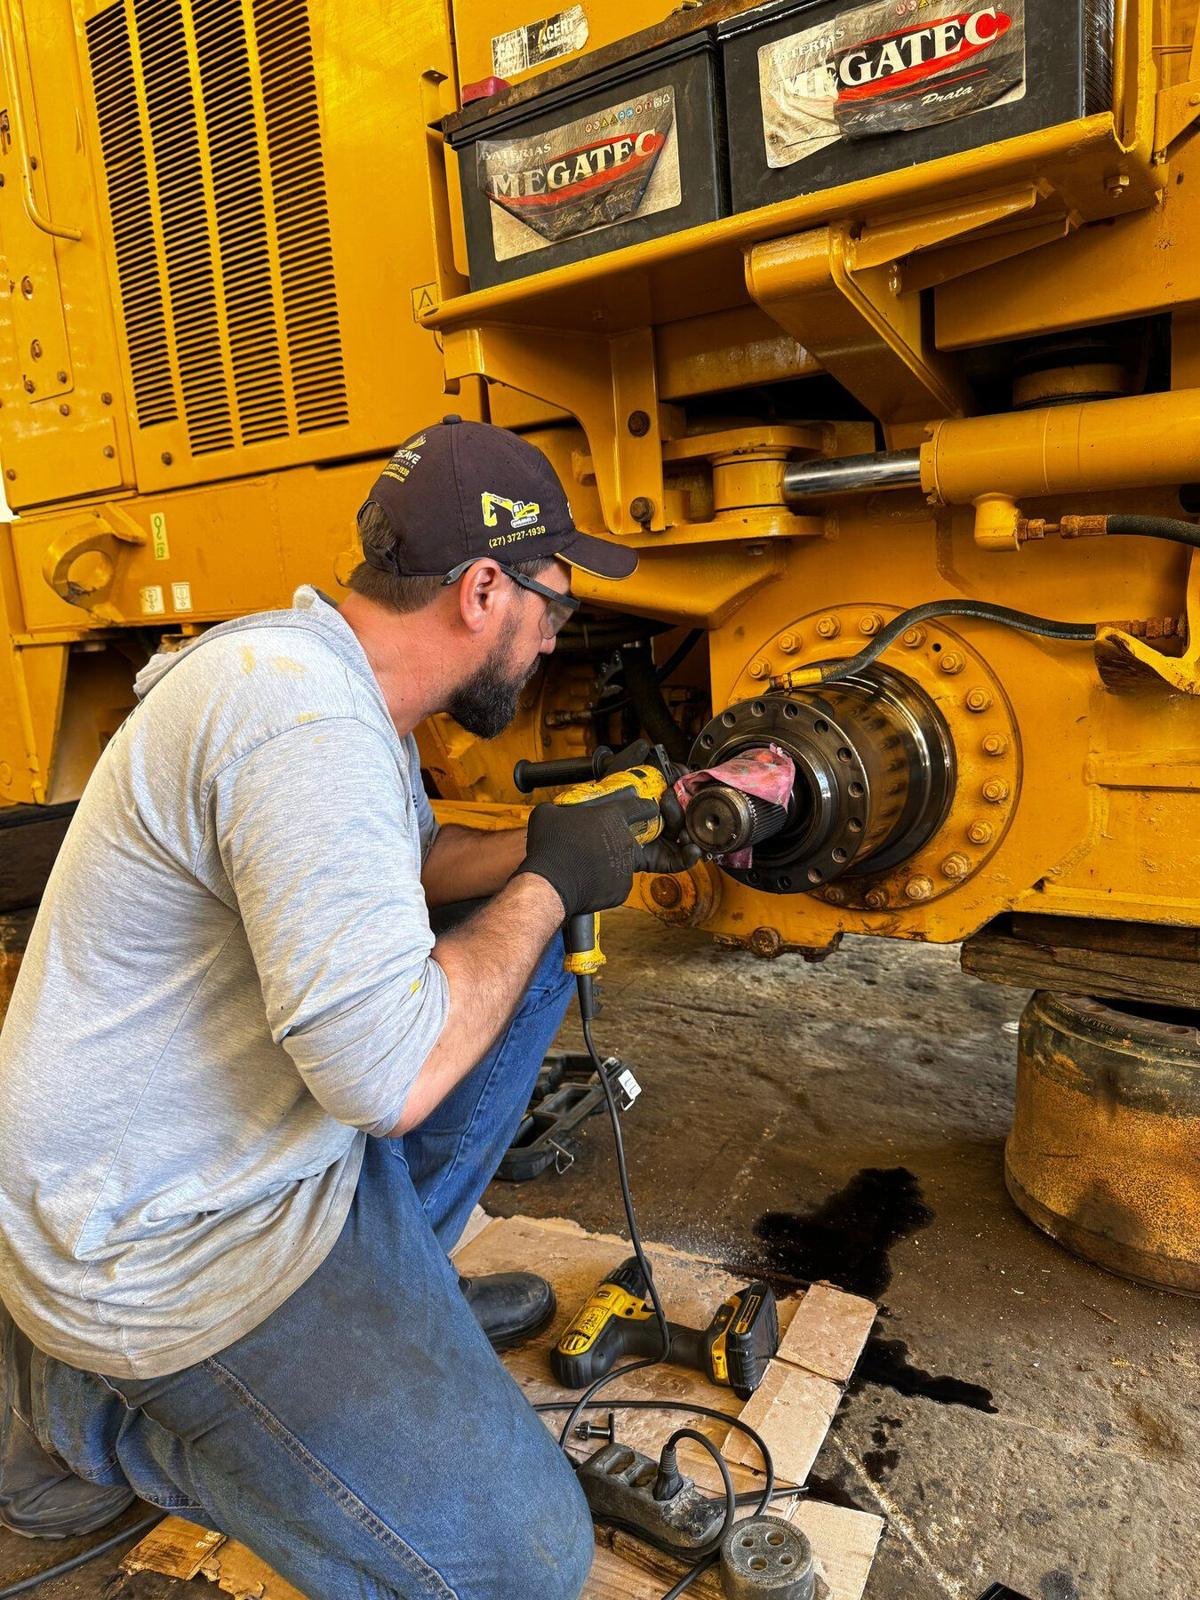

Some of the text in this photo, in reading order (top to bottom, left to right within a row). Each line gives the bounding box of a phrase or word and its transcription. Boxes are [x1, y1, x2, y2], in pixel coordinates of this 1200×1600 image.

[781, 7, 998, 98] MEGATEC
[843, 112, 887, 127] Liga
[920, 85, 975, 107] Prata
[491, 128, 657, 200] MEGATEC
[488, 525, 546, 549] (27) 3727-1939
